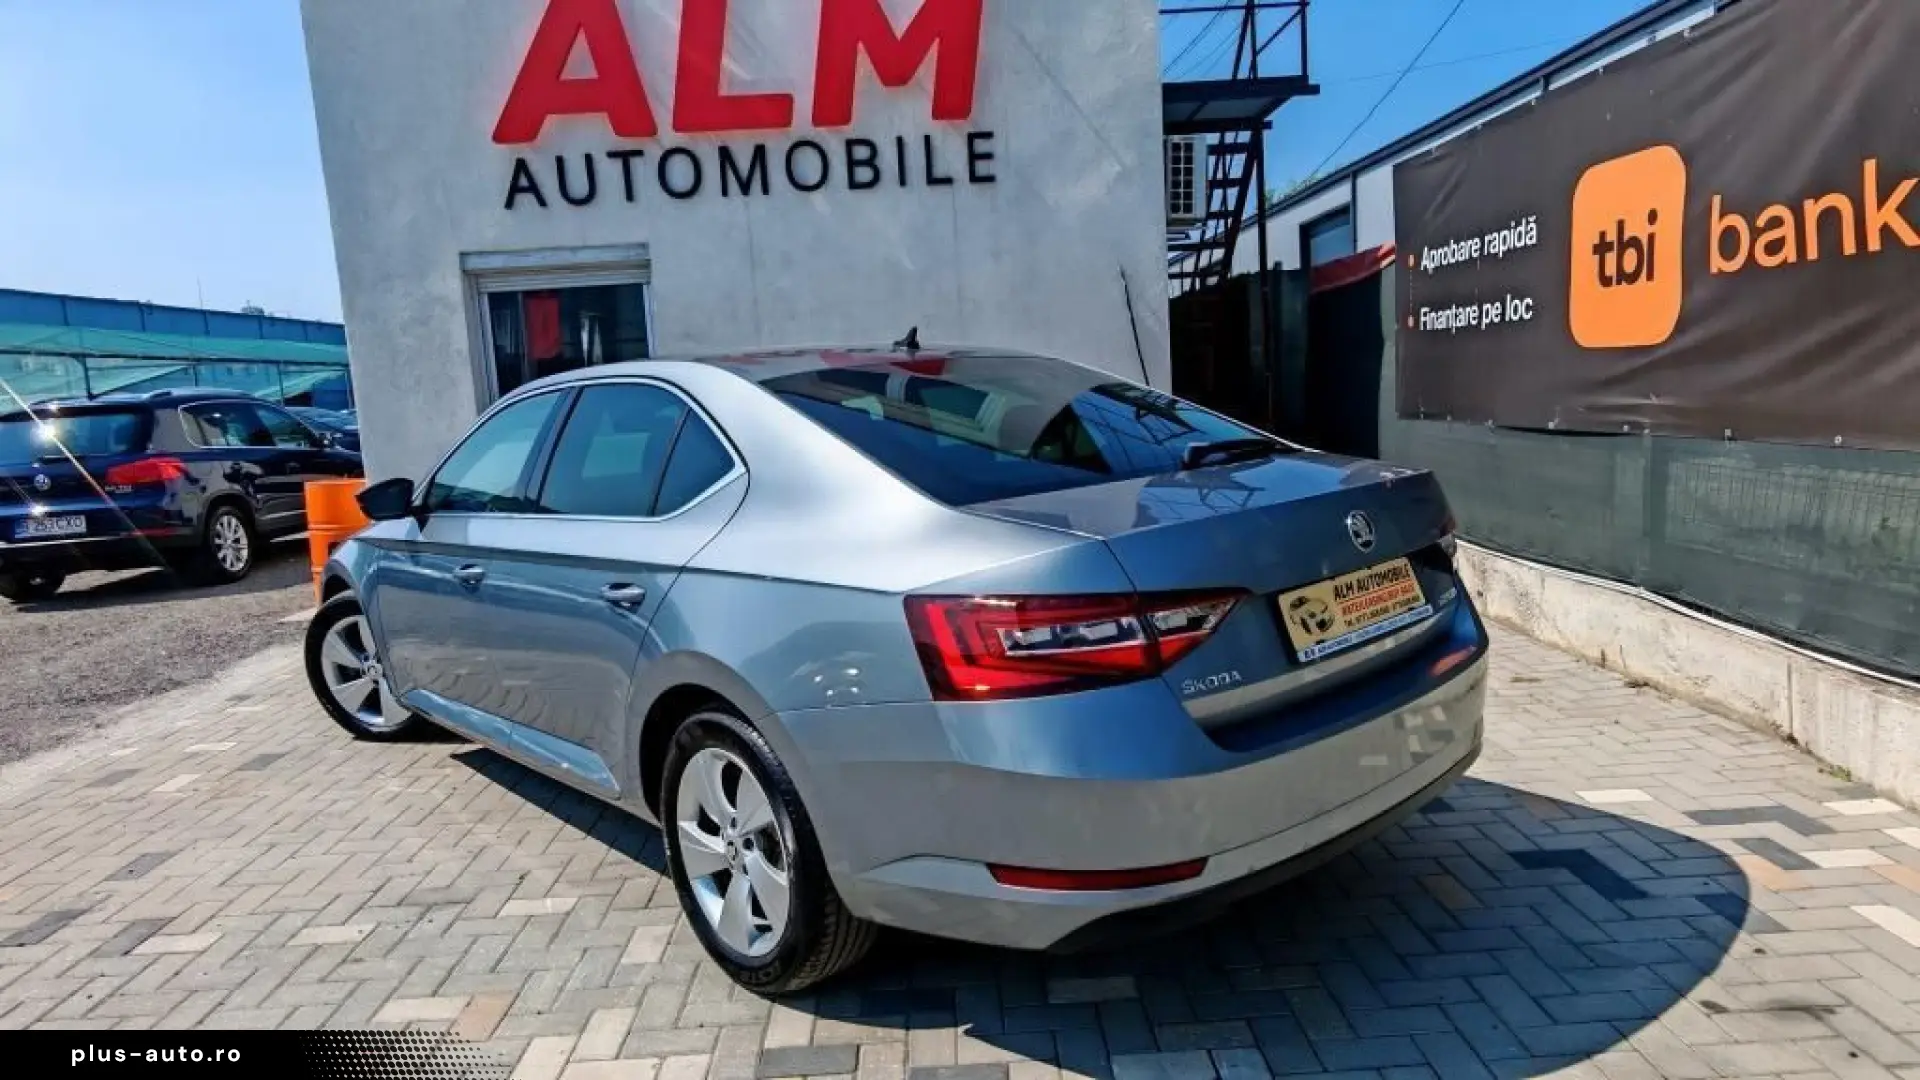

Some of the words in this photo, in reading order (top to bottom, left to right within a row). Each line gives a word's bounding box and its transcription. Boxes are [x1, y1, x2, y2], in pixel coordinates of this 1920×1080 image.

[493, 0, 984, 144] ALM
[504, 131, 997, 209] AUTOMOBILE
[1420, 234, 1481, 274] Aprobare
[1484, 214, 1538, 260] rapidă
[1592, 208, 1658, 288] tbi
[1710, 158, 1920, 275] bank
[1482, 305, 1501, 331] pe
[1505, 293, 1533, 323] loc
[1334, 580, 1355, 601] ALM
[1357, 563, 1411, 593] AUTOMOBILE
